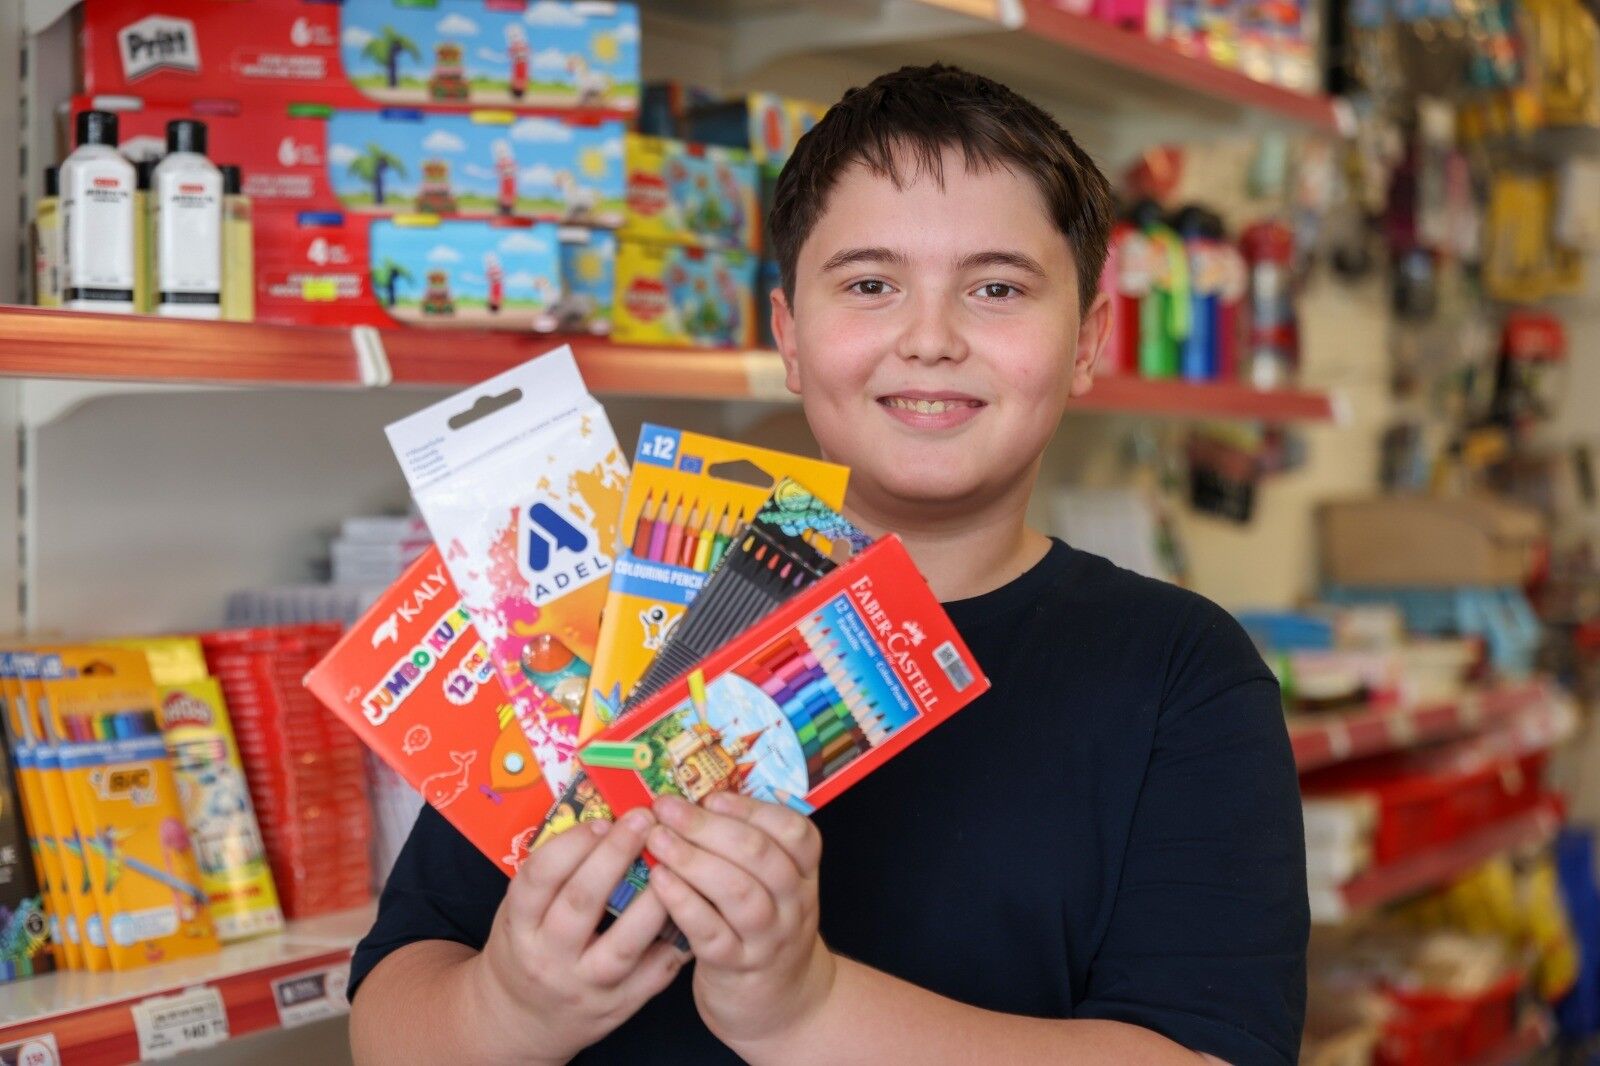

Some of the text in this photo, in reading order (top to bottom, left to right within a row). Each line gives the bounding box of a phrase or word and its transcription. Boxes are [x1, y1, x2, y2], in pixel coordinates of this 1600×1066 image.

[127, 29, 187, 60] Pritt
[642, 435, 675, 460] x12
[535, 556, 608, 600] ADEL
[615, 559, 671, 584] COLOURING
[396, 563, 448, 623] KALY
[834, 599, 849, 614] 12
[850, 575, 938, 712] FABER-CASTELL
[365, 650, 432, 721] JUMBO
[448, 674, 473, 698] 12
